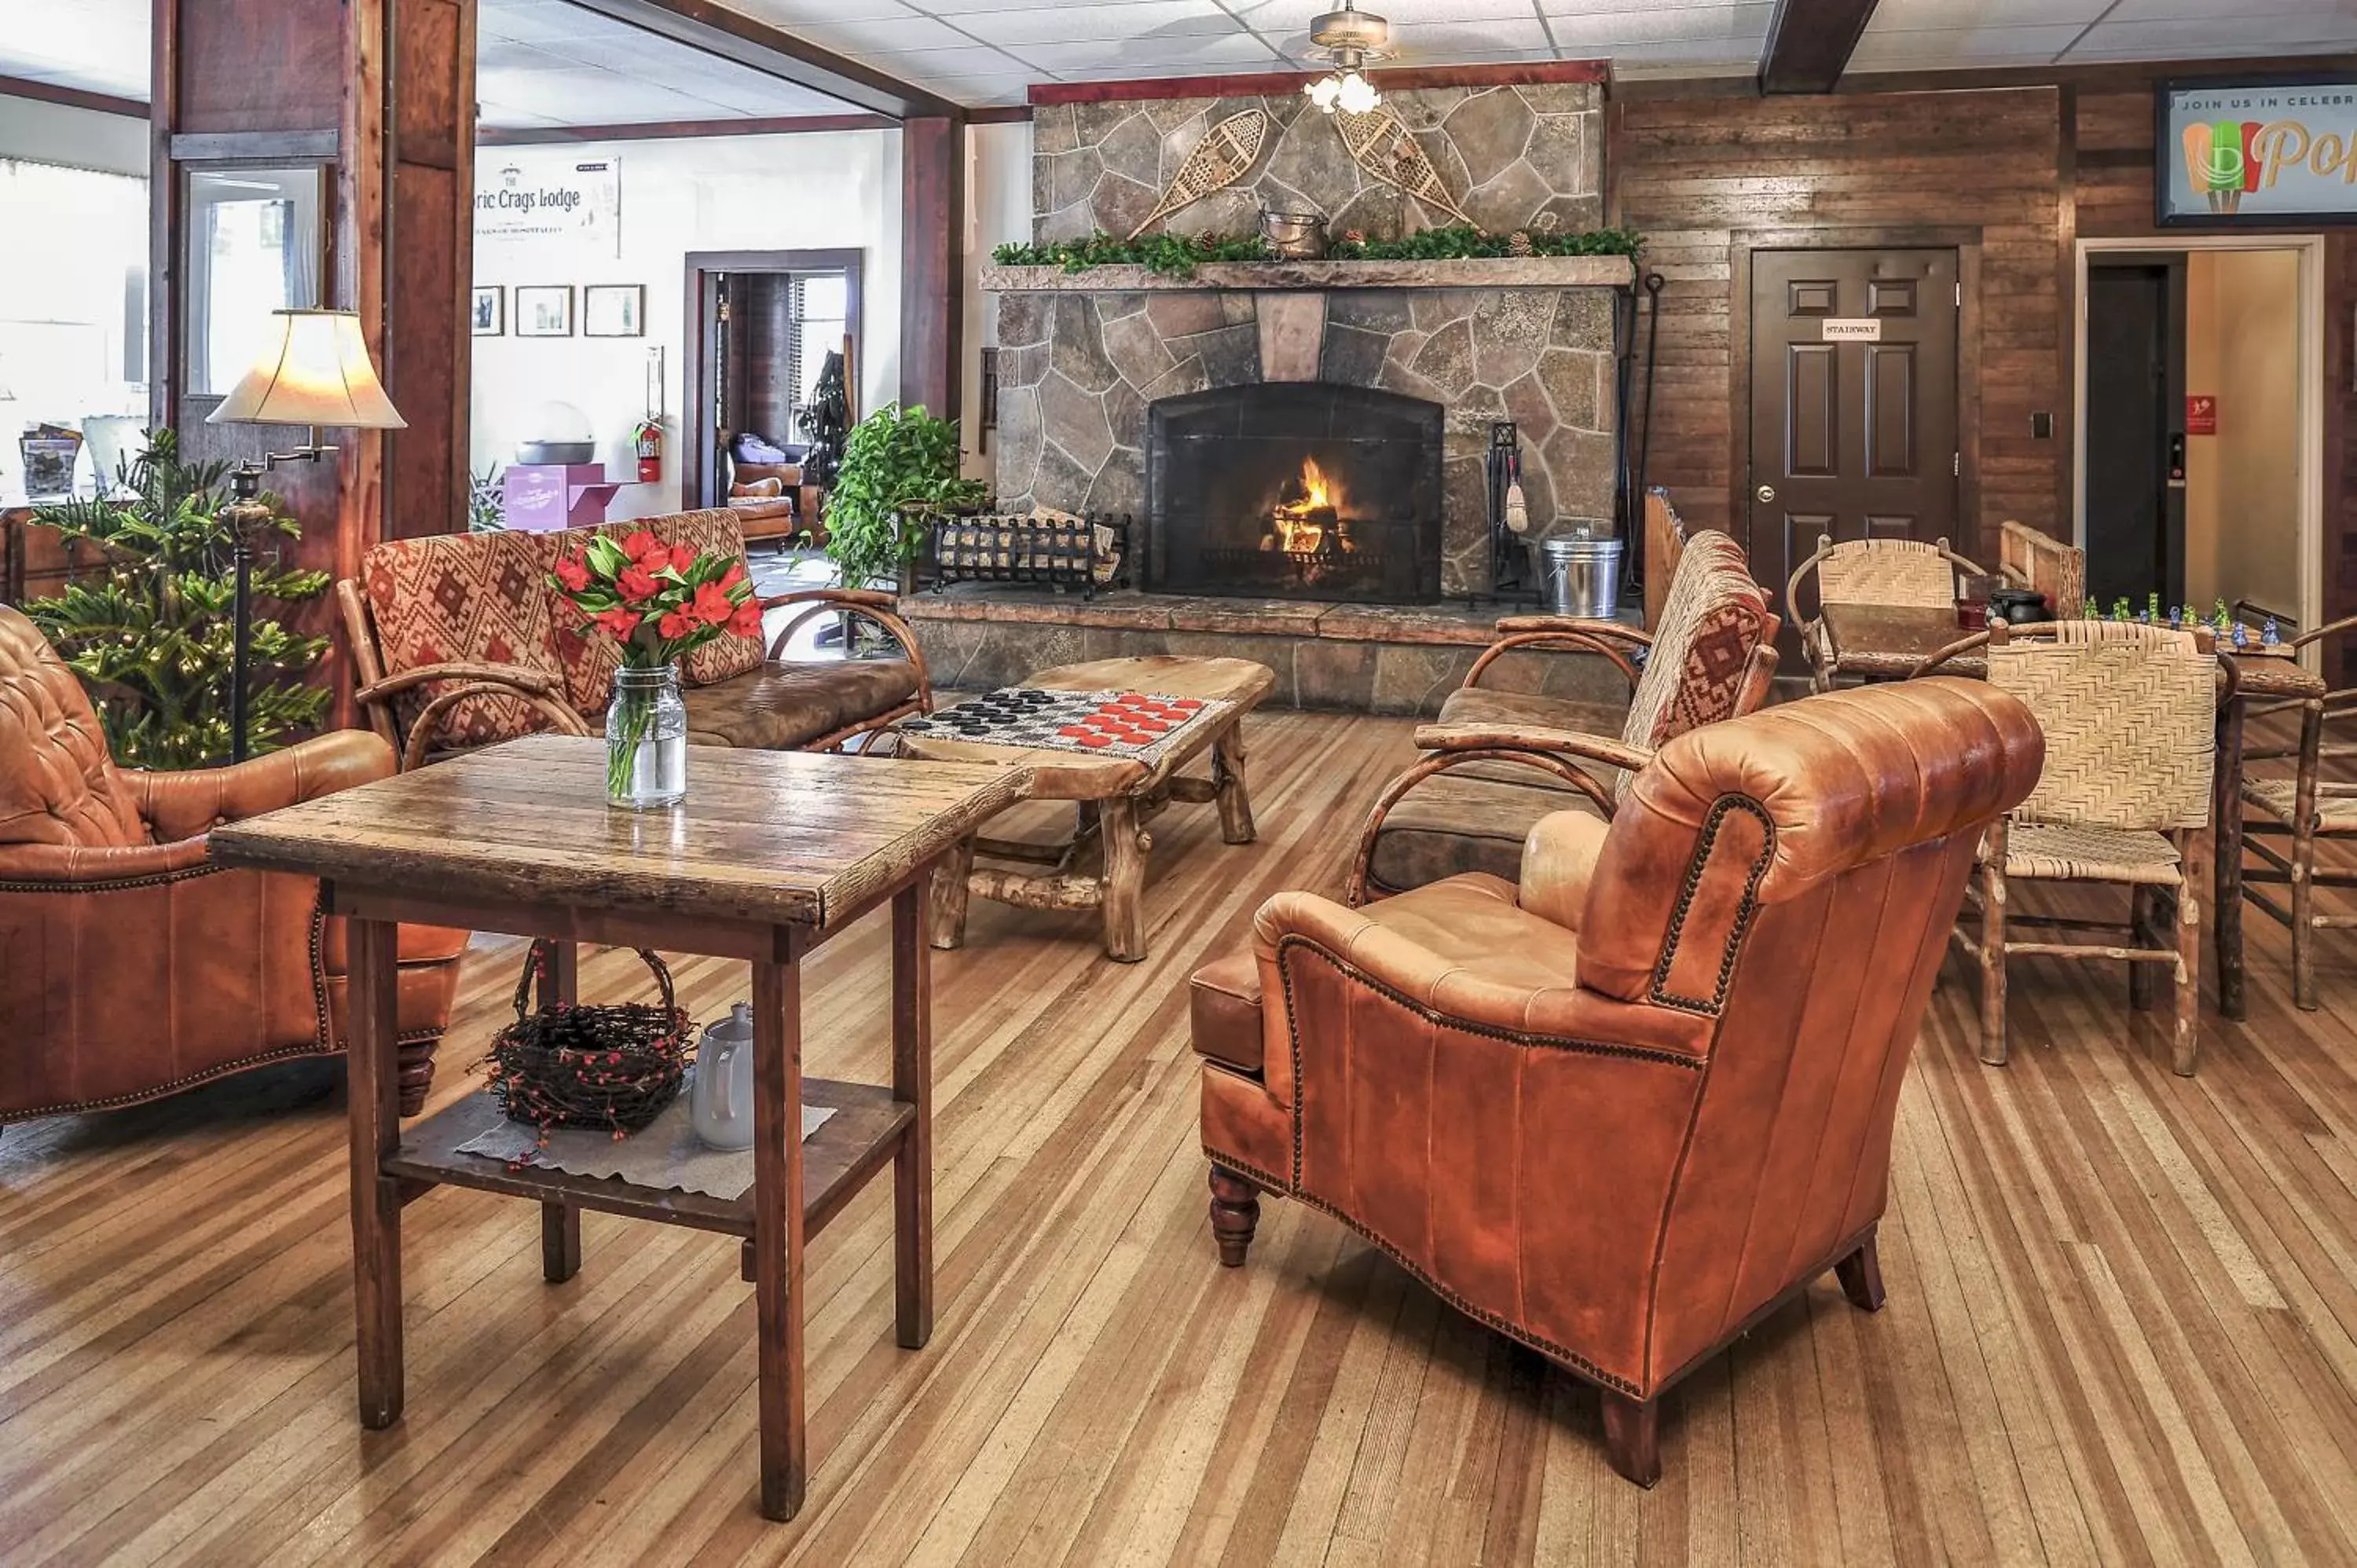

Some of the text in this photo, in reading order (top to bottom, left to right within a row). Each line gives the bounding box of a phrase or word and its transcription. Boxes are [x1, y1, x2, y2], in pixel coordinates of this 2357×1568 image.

[2183, 95, 2353, 110] JOIN US IN CELEBR
[475, 188, 580, 214] ric Crags Lodge
